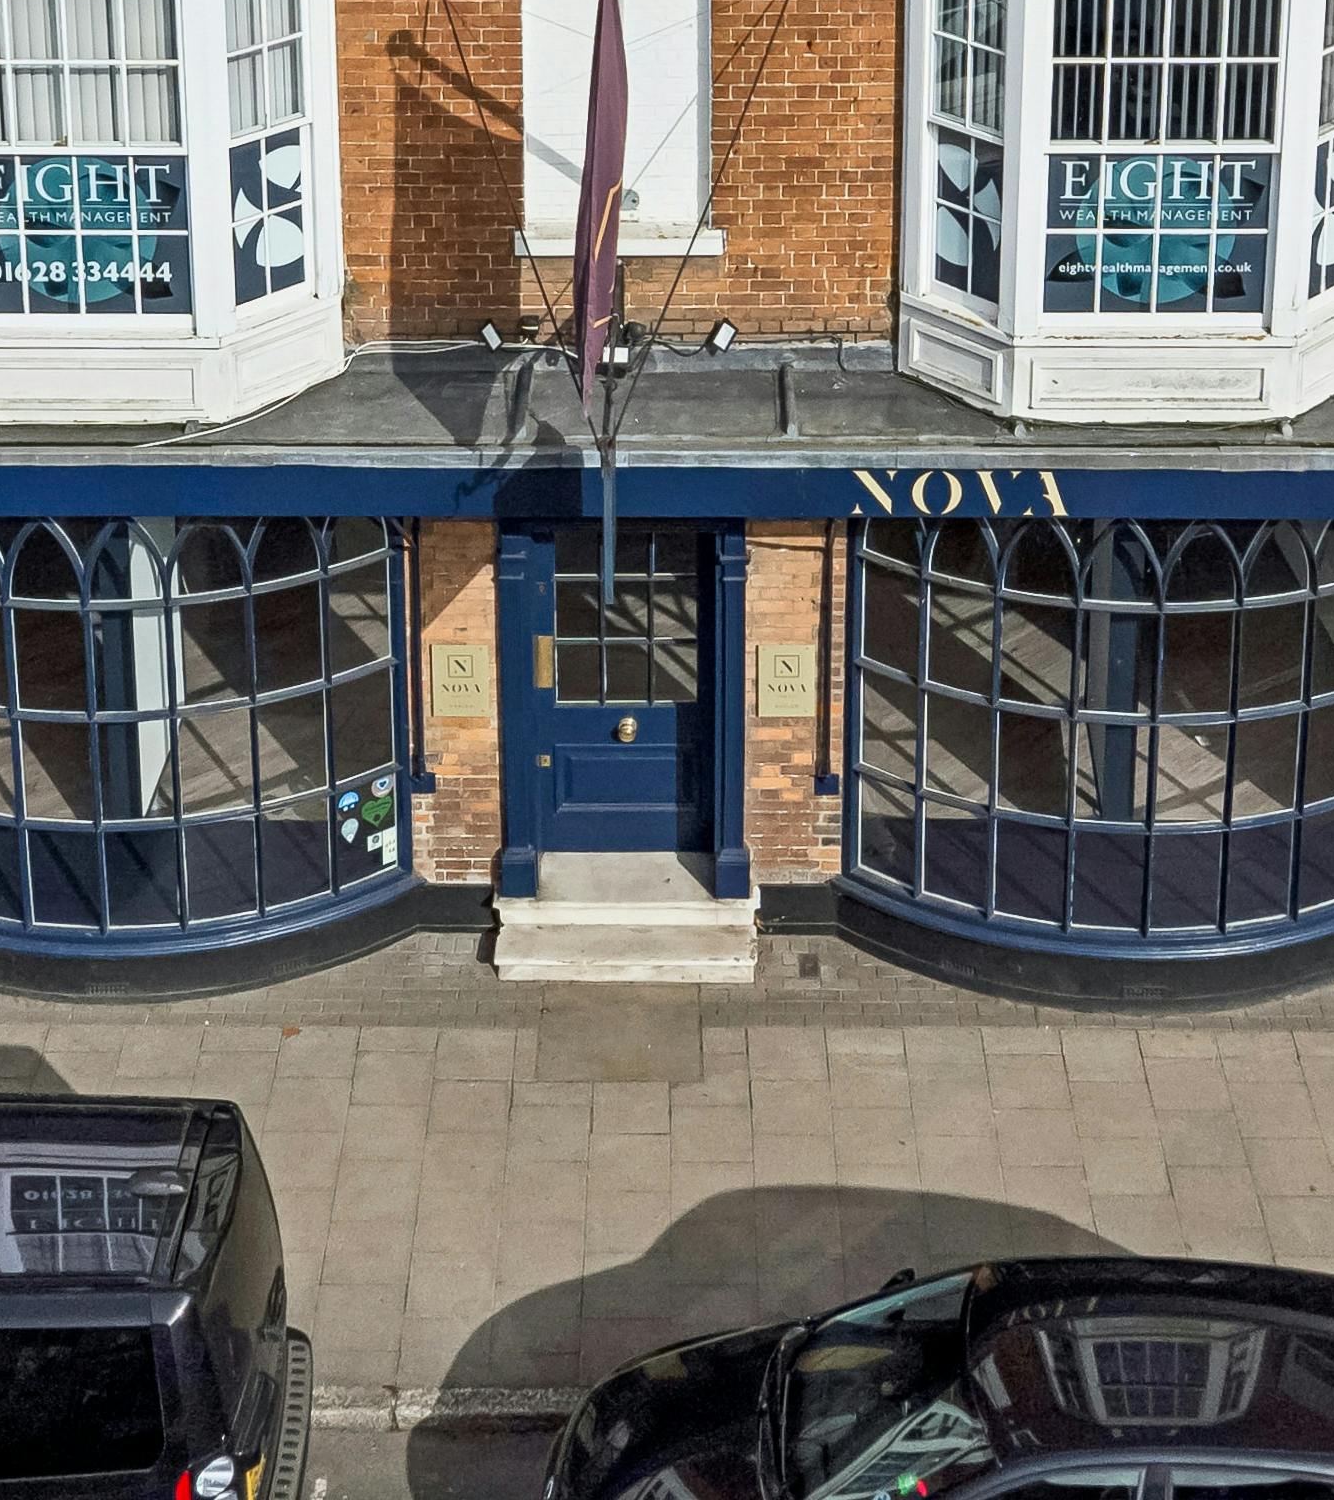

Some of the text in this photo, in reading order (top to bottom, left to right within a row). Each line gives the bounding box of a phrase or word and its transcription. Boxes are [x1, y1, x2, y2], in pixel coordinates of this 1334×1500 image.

[1060, 160, 1257, 200] EIGHT
[851, 469, 1069, 517] NOVA
[441, 683, 482, 693] NOVA
[767, 683, 807, 693] NOVA
